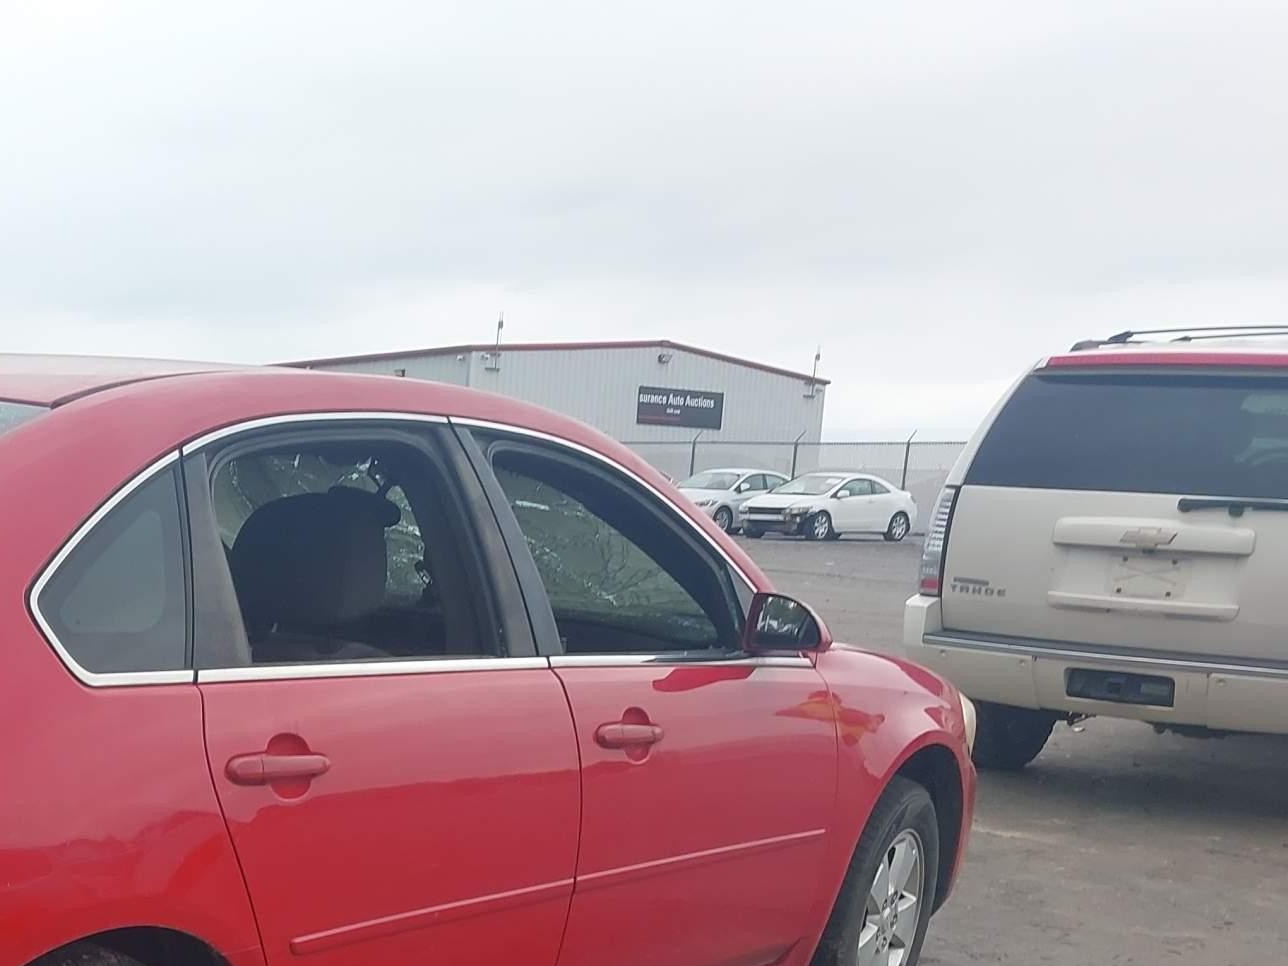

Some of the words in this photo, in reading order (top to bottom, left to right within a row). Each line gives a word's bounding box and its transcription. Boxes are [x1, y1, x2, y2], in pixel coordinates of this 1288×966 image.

[667, 393, 684, 406] Auto
[685, 394, 715, 409] Auctions
[951, 583, 1007, 597] TAHOE
